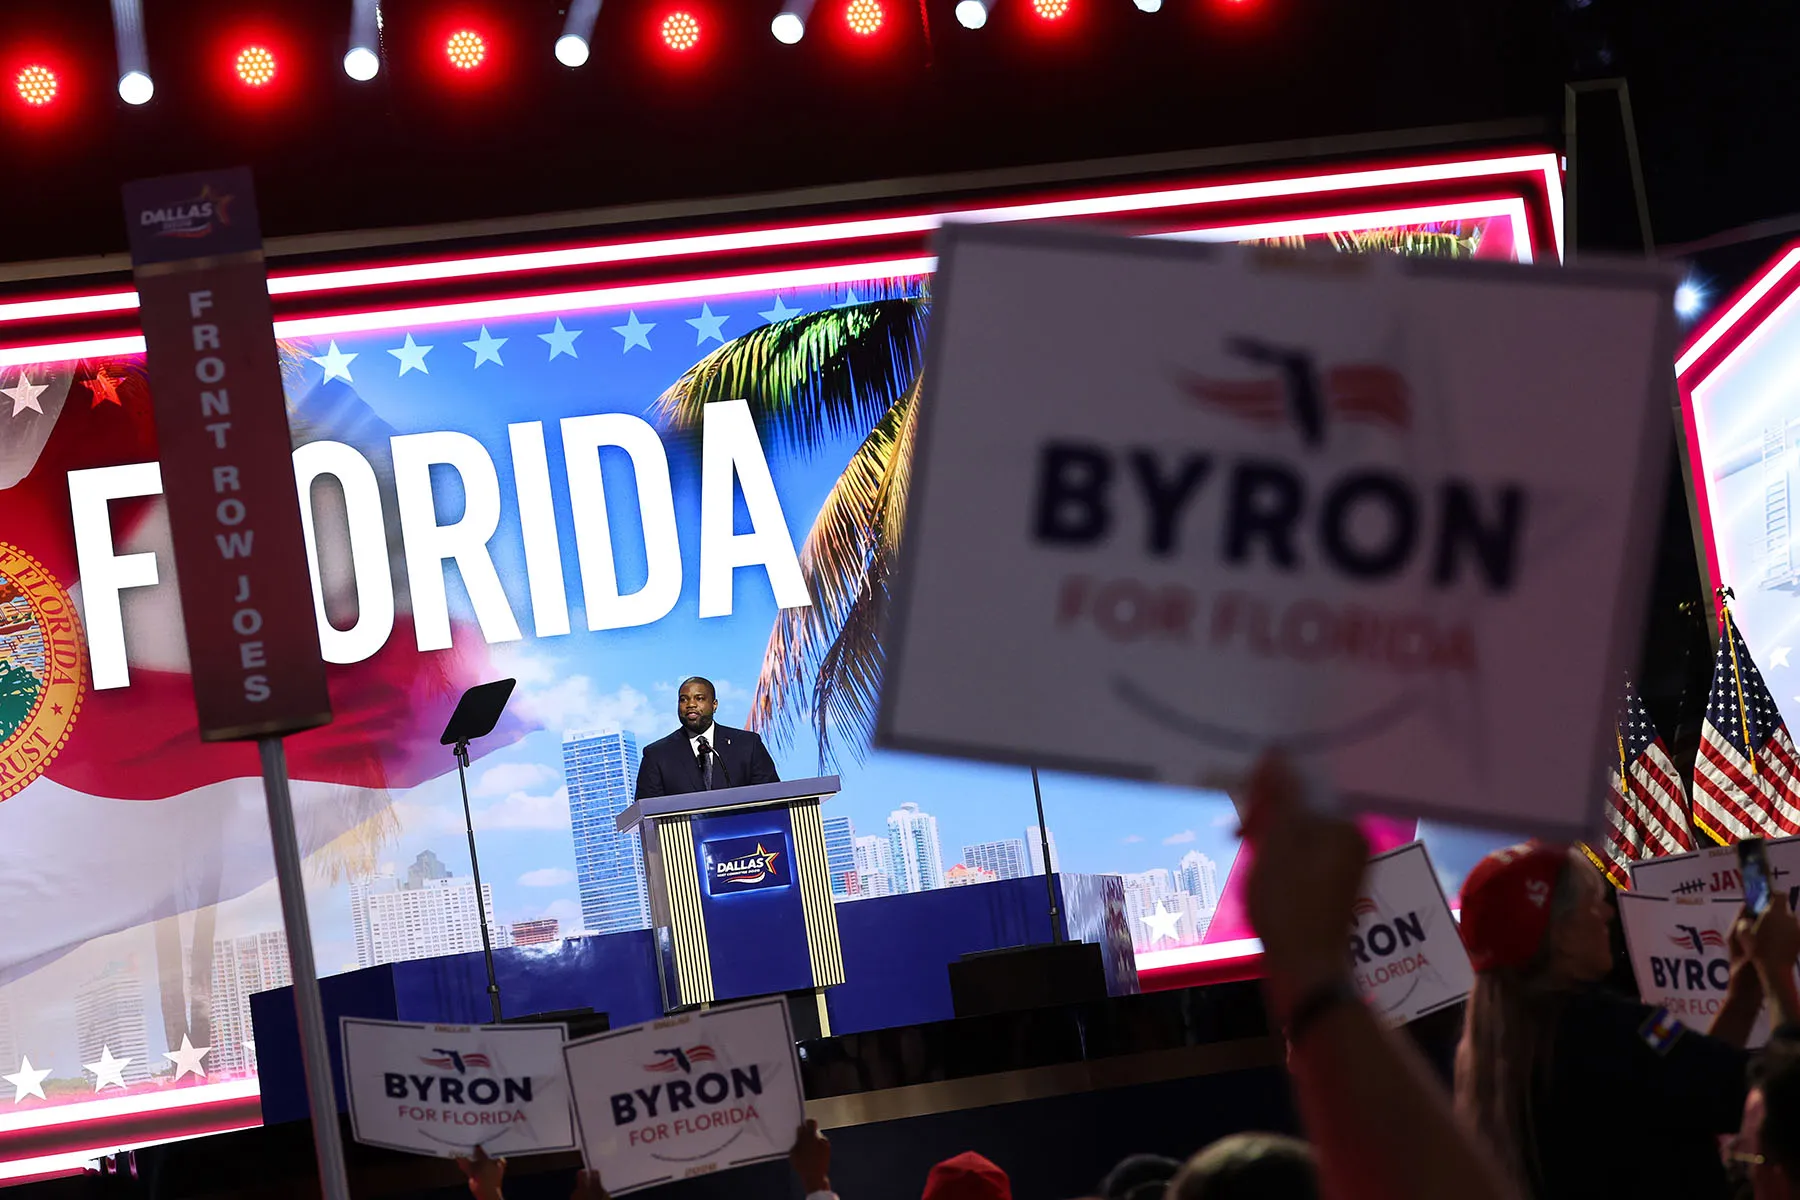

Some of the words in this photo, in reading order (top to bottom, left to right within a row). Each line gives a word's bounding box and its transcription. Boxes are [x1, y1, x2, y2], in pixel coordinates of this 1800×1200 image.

[141, 202, 213, 225] DALLAS
[189, 290, 231, 448] FRONT
[213, 466, 254, 559] ROW
[1031, 445, 1528, 594] BYRON
[67, 398, 812, 690] FORIDA
[14, 566, 77, 686] FLORIDA
[233, 576, 271, 702] JOES
[1059, 576, 1189, 641] FOR
[1210, 588, 1475, 667] FLORIDA
[0, 726, 51, 786] RUST
[717, 858, 764, 873] DALLAS
[1350, 911, 1426, 966] RON
[1650, 956, 1730, 991] BYRO
[384, 1073, 533, 1105] BYRON
[398, 1105, 437, 1122] FOR
[442, 1108, 527, 1126] FLORIDA
[611, 1064, 763, 1126] BYRON
[629, 1124, 669, 1147] FOR
[674, 1105, 760, 1137] FLORIDA
